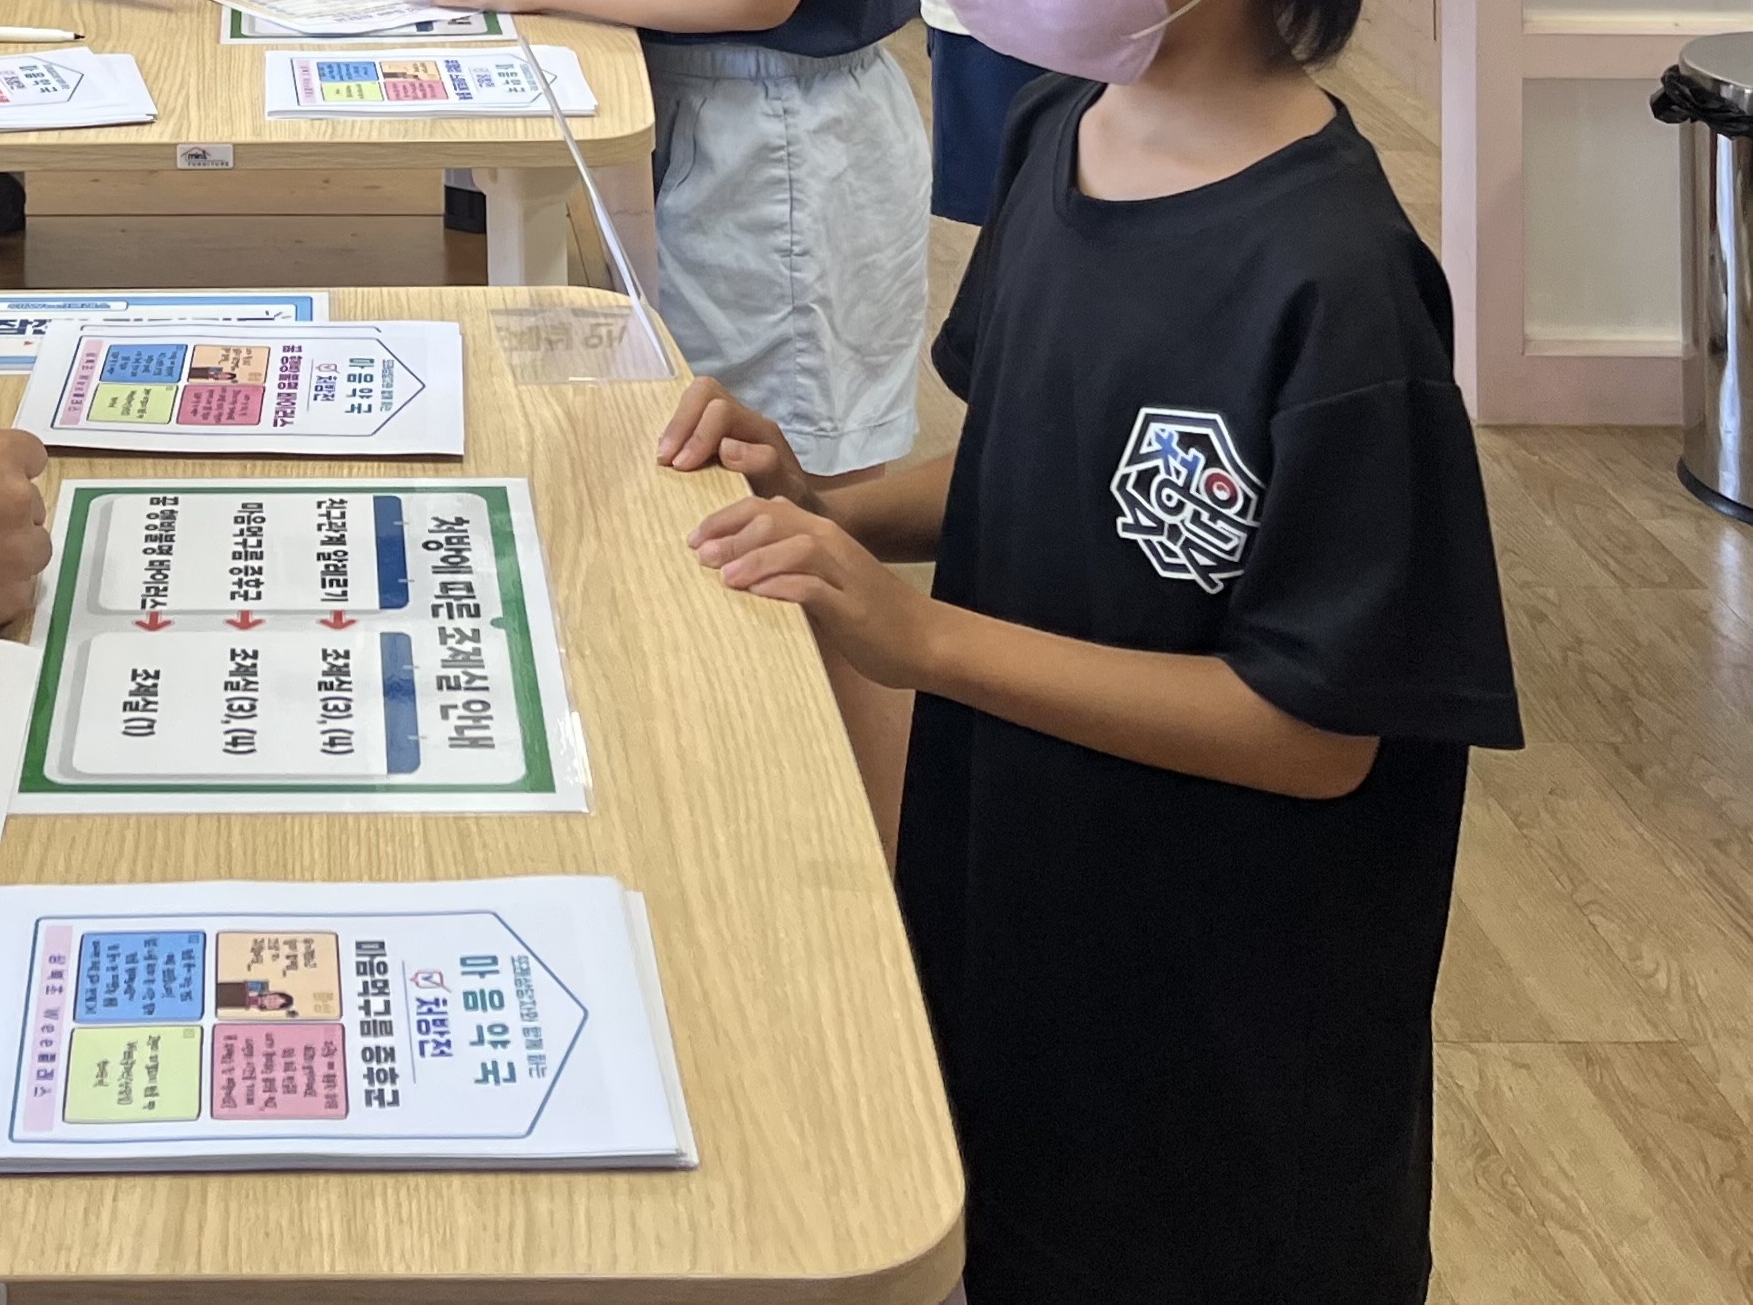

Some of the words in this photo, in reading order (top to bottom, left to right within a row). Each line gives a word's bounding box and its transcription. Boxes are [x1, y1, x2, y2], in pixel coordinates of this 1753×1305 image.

[232, 501, 266, 563] 마음먹구름
[316, 497, 347, 547] 친구관계
[422, 515, 473, 574] 처방에
[140, 559, 172, 610] 바이러스
[229, 566, 264, 602] 증후군
[316, 550, 348, 602] 알레르기
[431, 579, 480, 622] 따른
[224, 649, 259, 693] 조제실
[317, 648, 351, 693] 조제실
[436, 625, 486, 693] 조제실
[122, 669, 160, 714] 조제실
[220, 696, 257, 725] (3),
[317, 697, 352, 725] (3),
[121, 719, 156, 737] (1)
[222, 728, 257, 755] (4)
[321, 729, 355, 755] (4)
[439, 699, 495, 750] 안내
[354, 939, 396, 1040] 마음먹구름
[416, 995, 454, 1059] 처방전
[360, 1042, 401, 1109] 증후군
